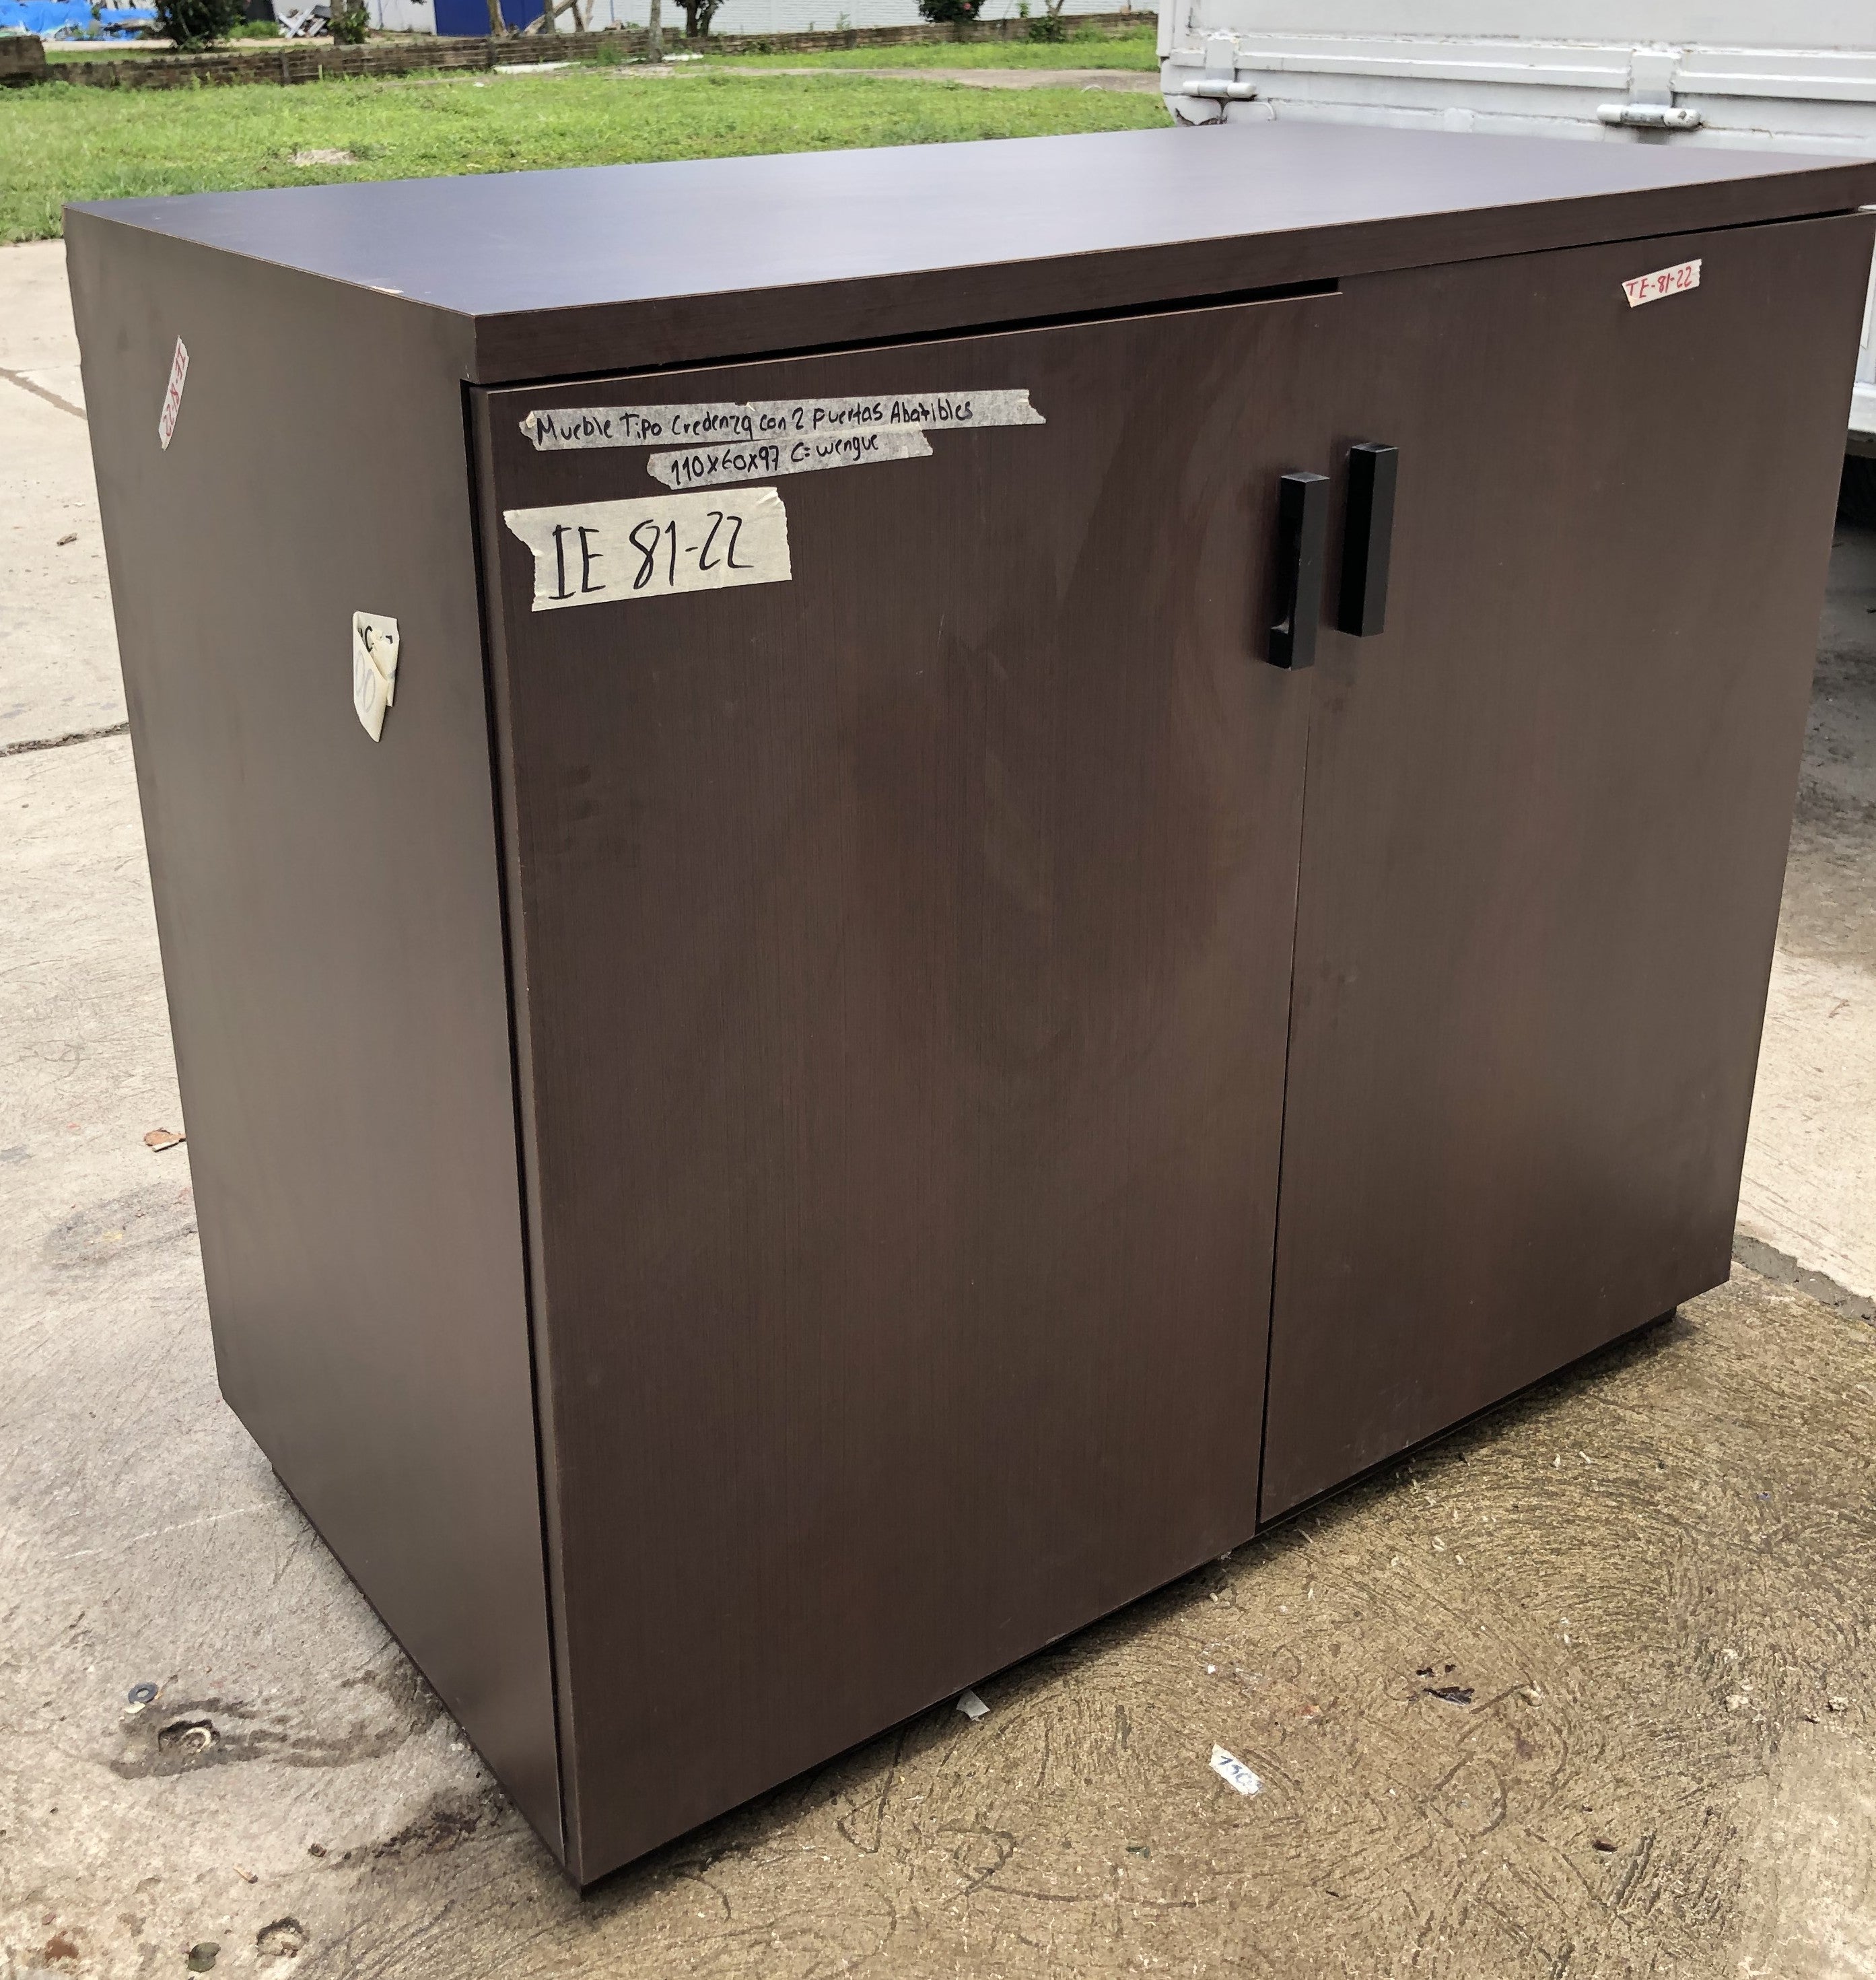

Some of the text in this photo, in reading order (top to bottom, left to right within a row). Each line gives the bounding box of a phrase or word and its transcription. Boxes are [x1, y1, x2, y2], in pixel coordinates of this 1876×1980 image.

[538, 414, 611, 446] Mueble
[621, 413, 662, 440] Tipo
[673, 412, 753, 440] Credenza
[792, 407, 804, 430] 2
[890, 399, 973, 423] Abatibles
[629, 511, 755, 590] 81-22
